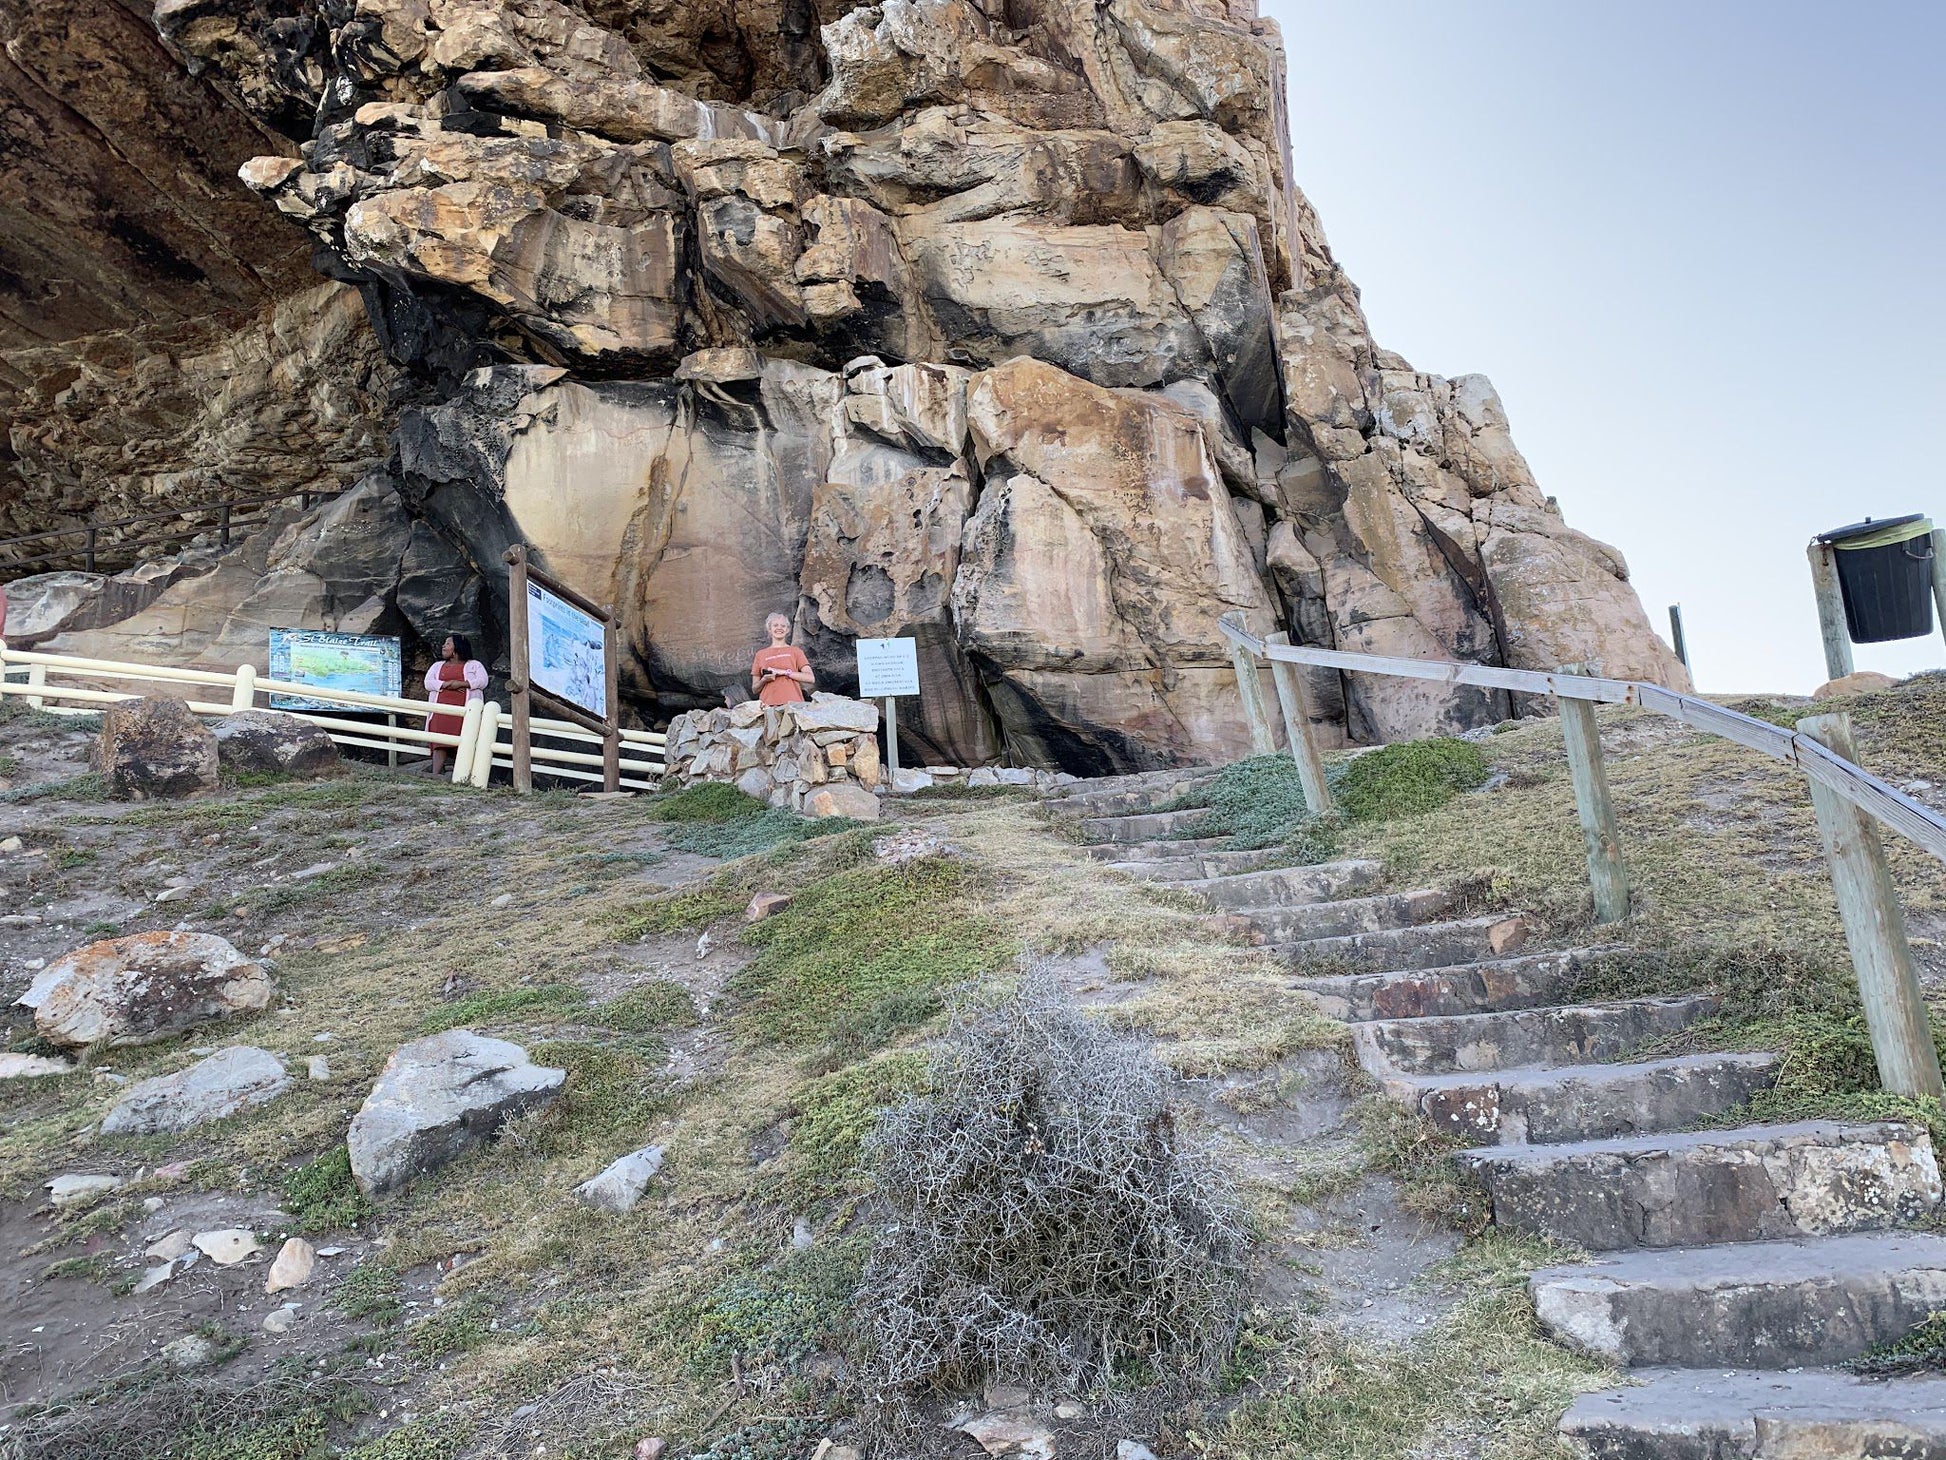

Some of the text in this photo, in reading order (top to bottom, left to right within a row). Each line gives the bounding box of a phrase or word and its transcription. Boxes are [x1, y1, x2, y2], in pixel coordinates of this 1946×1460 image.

[301, 634, 315, 643] St
[318, 634, 347, 646] Blaise
[350, 637, 378, 647] Trail
